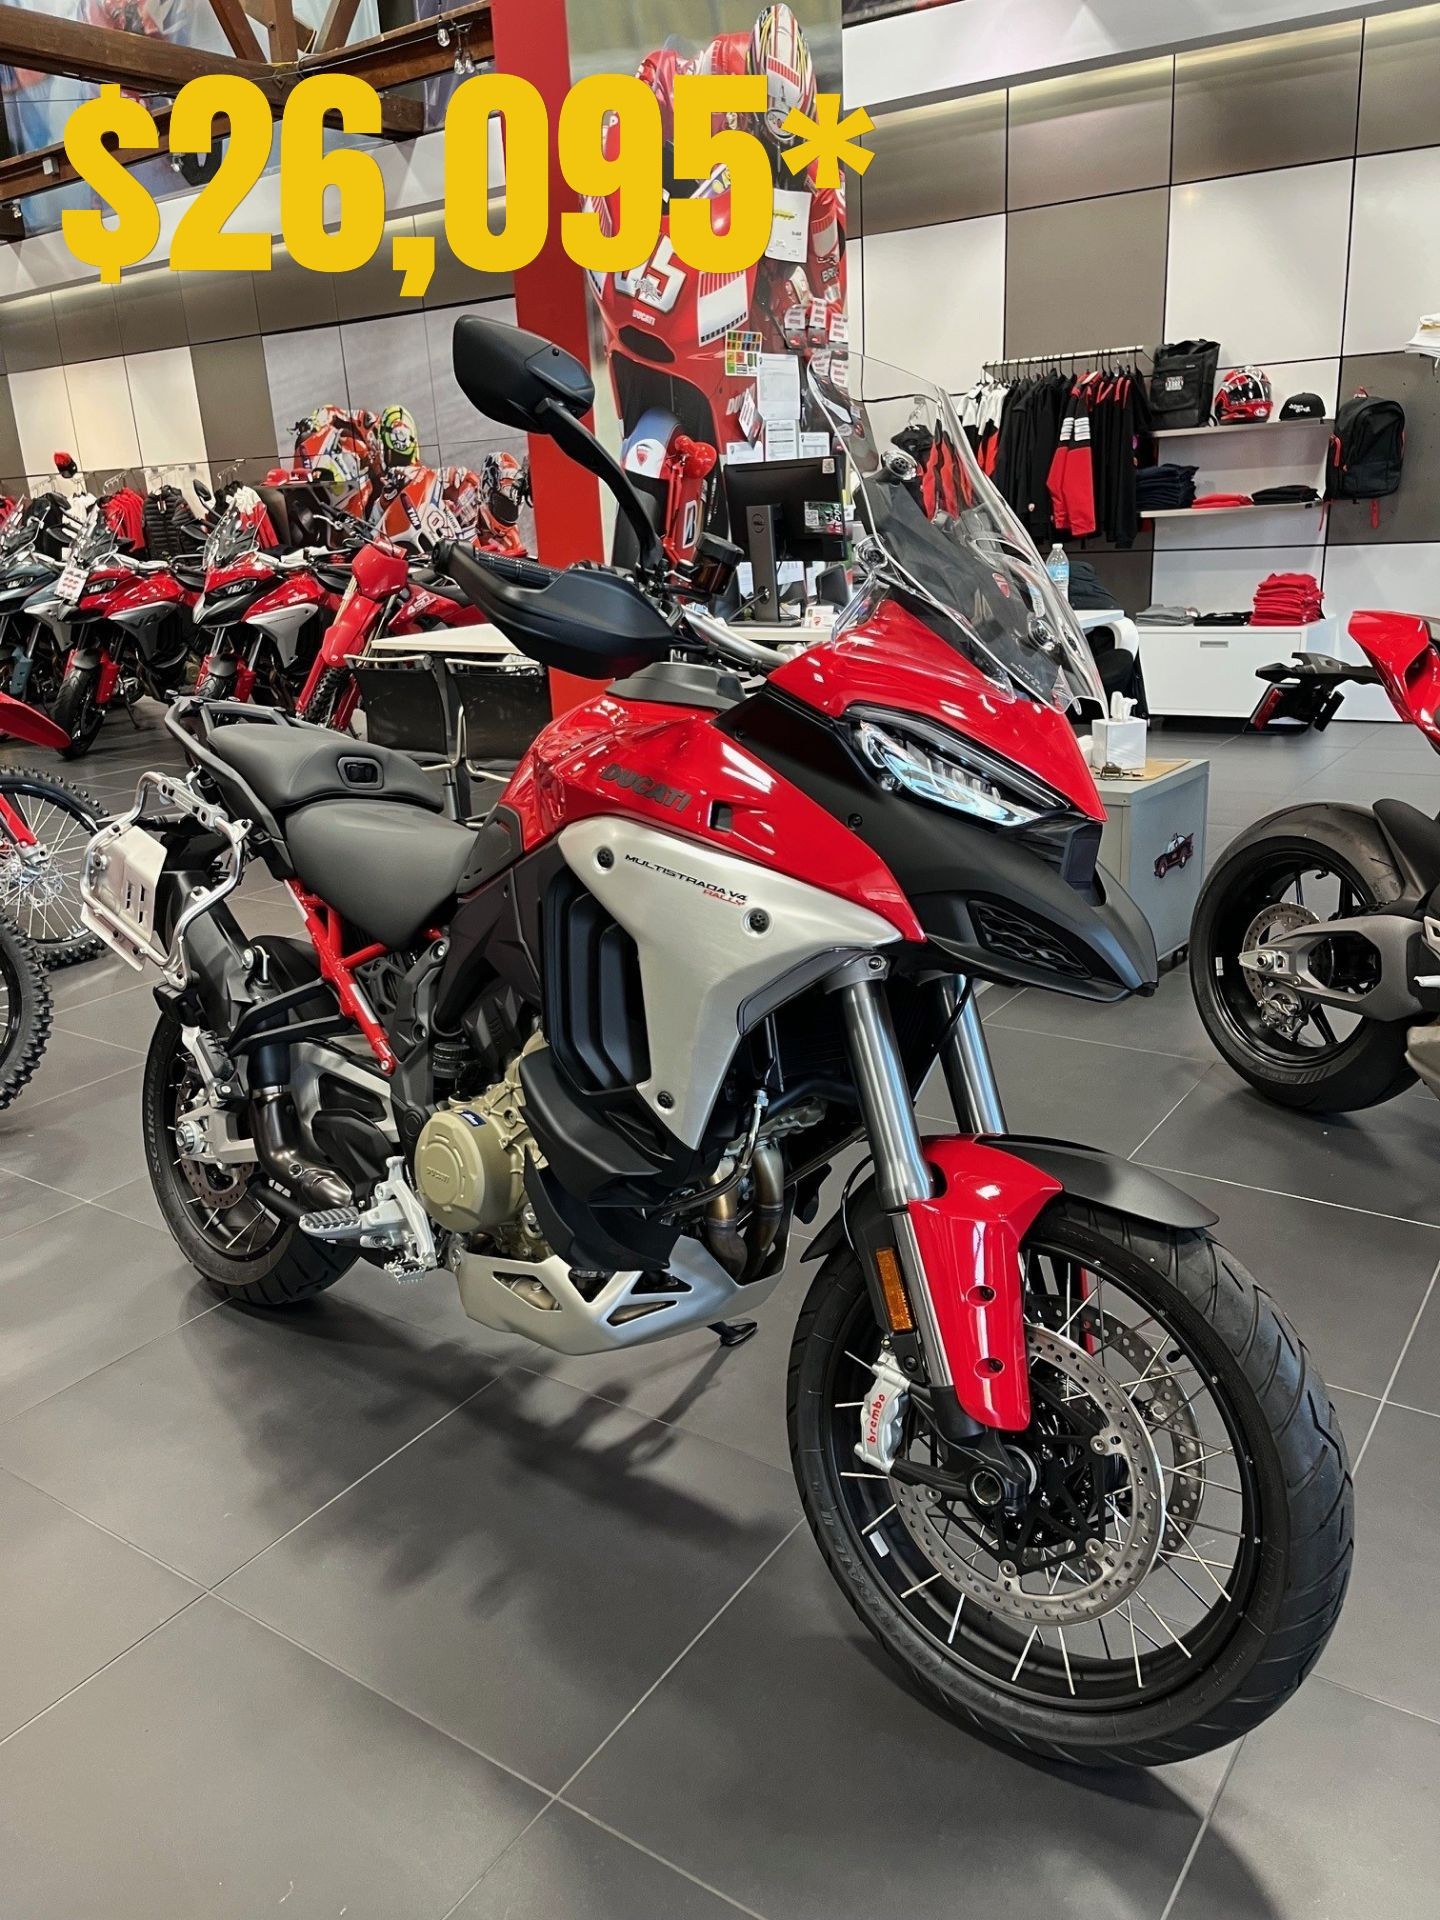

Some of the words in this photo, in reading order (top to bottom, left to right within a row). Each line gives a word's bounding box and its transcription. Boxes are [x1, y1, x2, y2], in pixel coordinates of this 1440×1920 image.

[407, 507, 421, 526] TIM
[602, 763, 693, 813] DUCATI
[625, 854, 726, 895] MULTISTRADA
[729, 890, 748, 901] V4
[703, 887, 746, 906] RALLY
[867, 1394, 886, 1443] brembo
